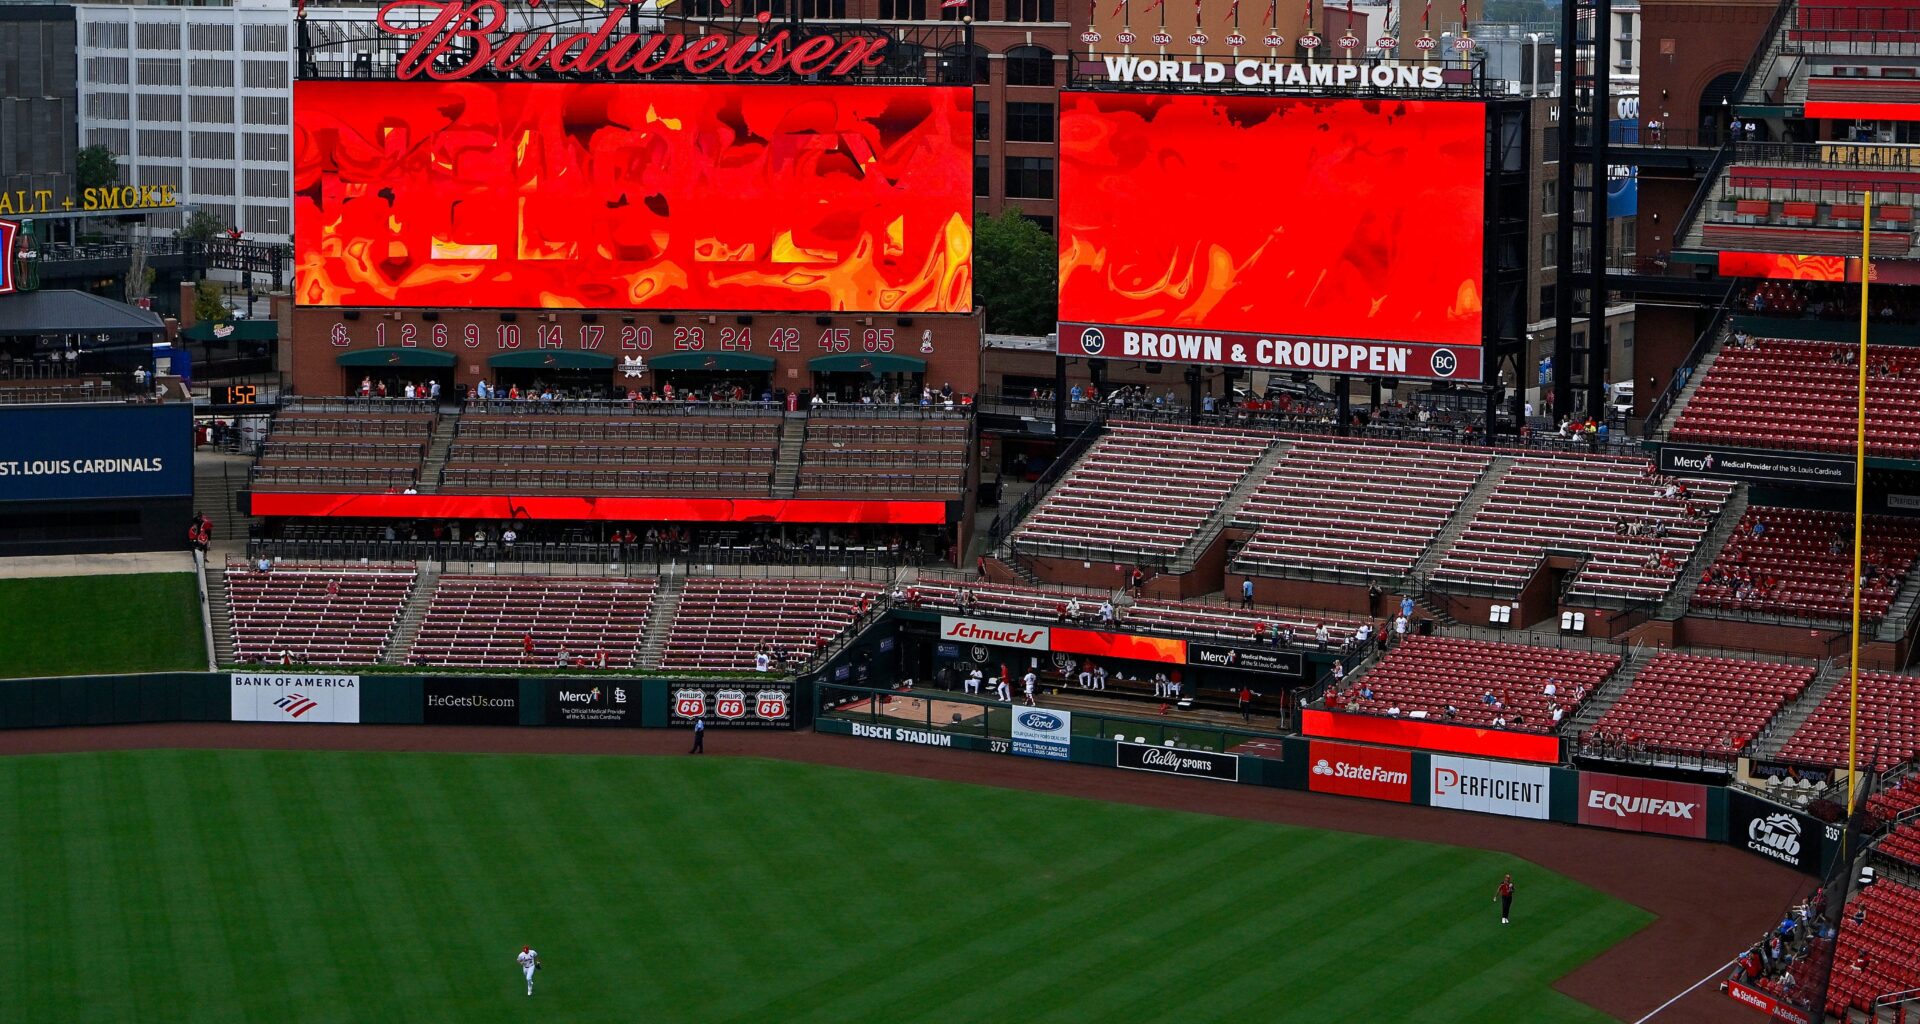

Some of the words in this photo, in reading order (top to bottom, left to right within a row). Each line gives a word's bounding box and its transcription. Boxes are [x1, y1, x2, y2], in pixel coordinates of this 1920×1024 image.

[377, 0, 888, 80] Budweiser
[1081, 34, 1098, 42] 1926
[1118, 34, 1133, 42] 1931
[1153, 35, 1169, 43] 1934
[1189, 35, 1205, 43] 1942
[1226, 36, 1243, 44] 1944
[1264, 37, 1281, 45] 1946
[1301, 38, 1318, 46] 1964
[1340, 38, 1356, 46] 1967
[1378, 39, 1395, 47] 1982
[1417, 39, 1435, 48] 2006
[1456, 40, 1472, 49] 2011
[1104, 56, 1226, 83] WORLD
[1235, 60, 1443, 88] CHAMPIONS
[84, 185, 177, 211] SMOKE
[376, 322, 386, 347] 1
[401, 323, 417, 347] 2
[432, 323, 448, 347] 6
[464, 323, 480, 348] 9
[496, 324, 521, 349] 10
[537, 324, 563, 349] 14
[579, 325, 605, 350] 17
[621, 325, 653, 350] 20
[673, 326, 705, 351] 23
[720, 326, 751, 351] 24
[768, 327, 800, 352] 42
[818, 328, 850, 352] 45
[862, 328, 895, 352] 85
[1123, 331, 1223, 361] BROWN
[1230, 342, 1248, 364] &
[1256, 338, 1407, 372] CROUPPEN
[227, 385, 256, 404] 1:52
[0, 461, 20, 476] ST.
[24, 460, 71, 475] LOUIS
[73, 457, 163, 473] CARDINALS
[1674, 456, 1706, 471] Mercy
[1721, 460, 1746, 469] Medical
[1746, 462, 1771, 471] Provider
[1798, 466, 1813, 474] Louis
[1814, 467, 1842, 476] Cardinals
[946, 621, 1044, 644] Schnucks
[974, 647, 985, 655] DK
[1200, 650, 1230, 665] Mercy
[235, 677, 273, 687] BANK
[275, 677, 292, 687] OF
[295, 677, 355, 688] AMERICA
[428, 695, 515, 708] HeGetsUs.com
[559, 691, 592, 704] Mercy
[680, 701, 700, 713] 66
[720, 702, 740, 713] 66
[761, 702, 780, 714] 66
[1027, 713, 1054, 729] Ford
[852, 722, 892, 740] BUSCH
[895, 728, 951, 747] STADIUM
[990, 740, 1009, 753] 375'
[1142, 748, 1182, 771] Bally
[1182, 758, 1211, 771] SPORTS
[1434, 767, 1543, 804] PERFICIENT
[1587, 789, 1696, 820] EQUIFAX
[1748, 817, 1801, 856] Club
[1825, 826, 1840, 841] 335'
